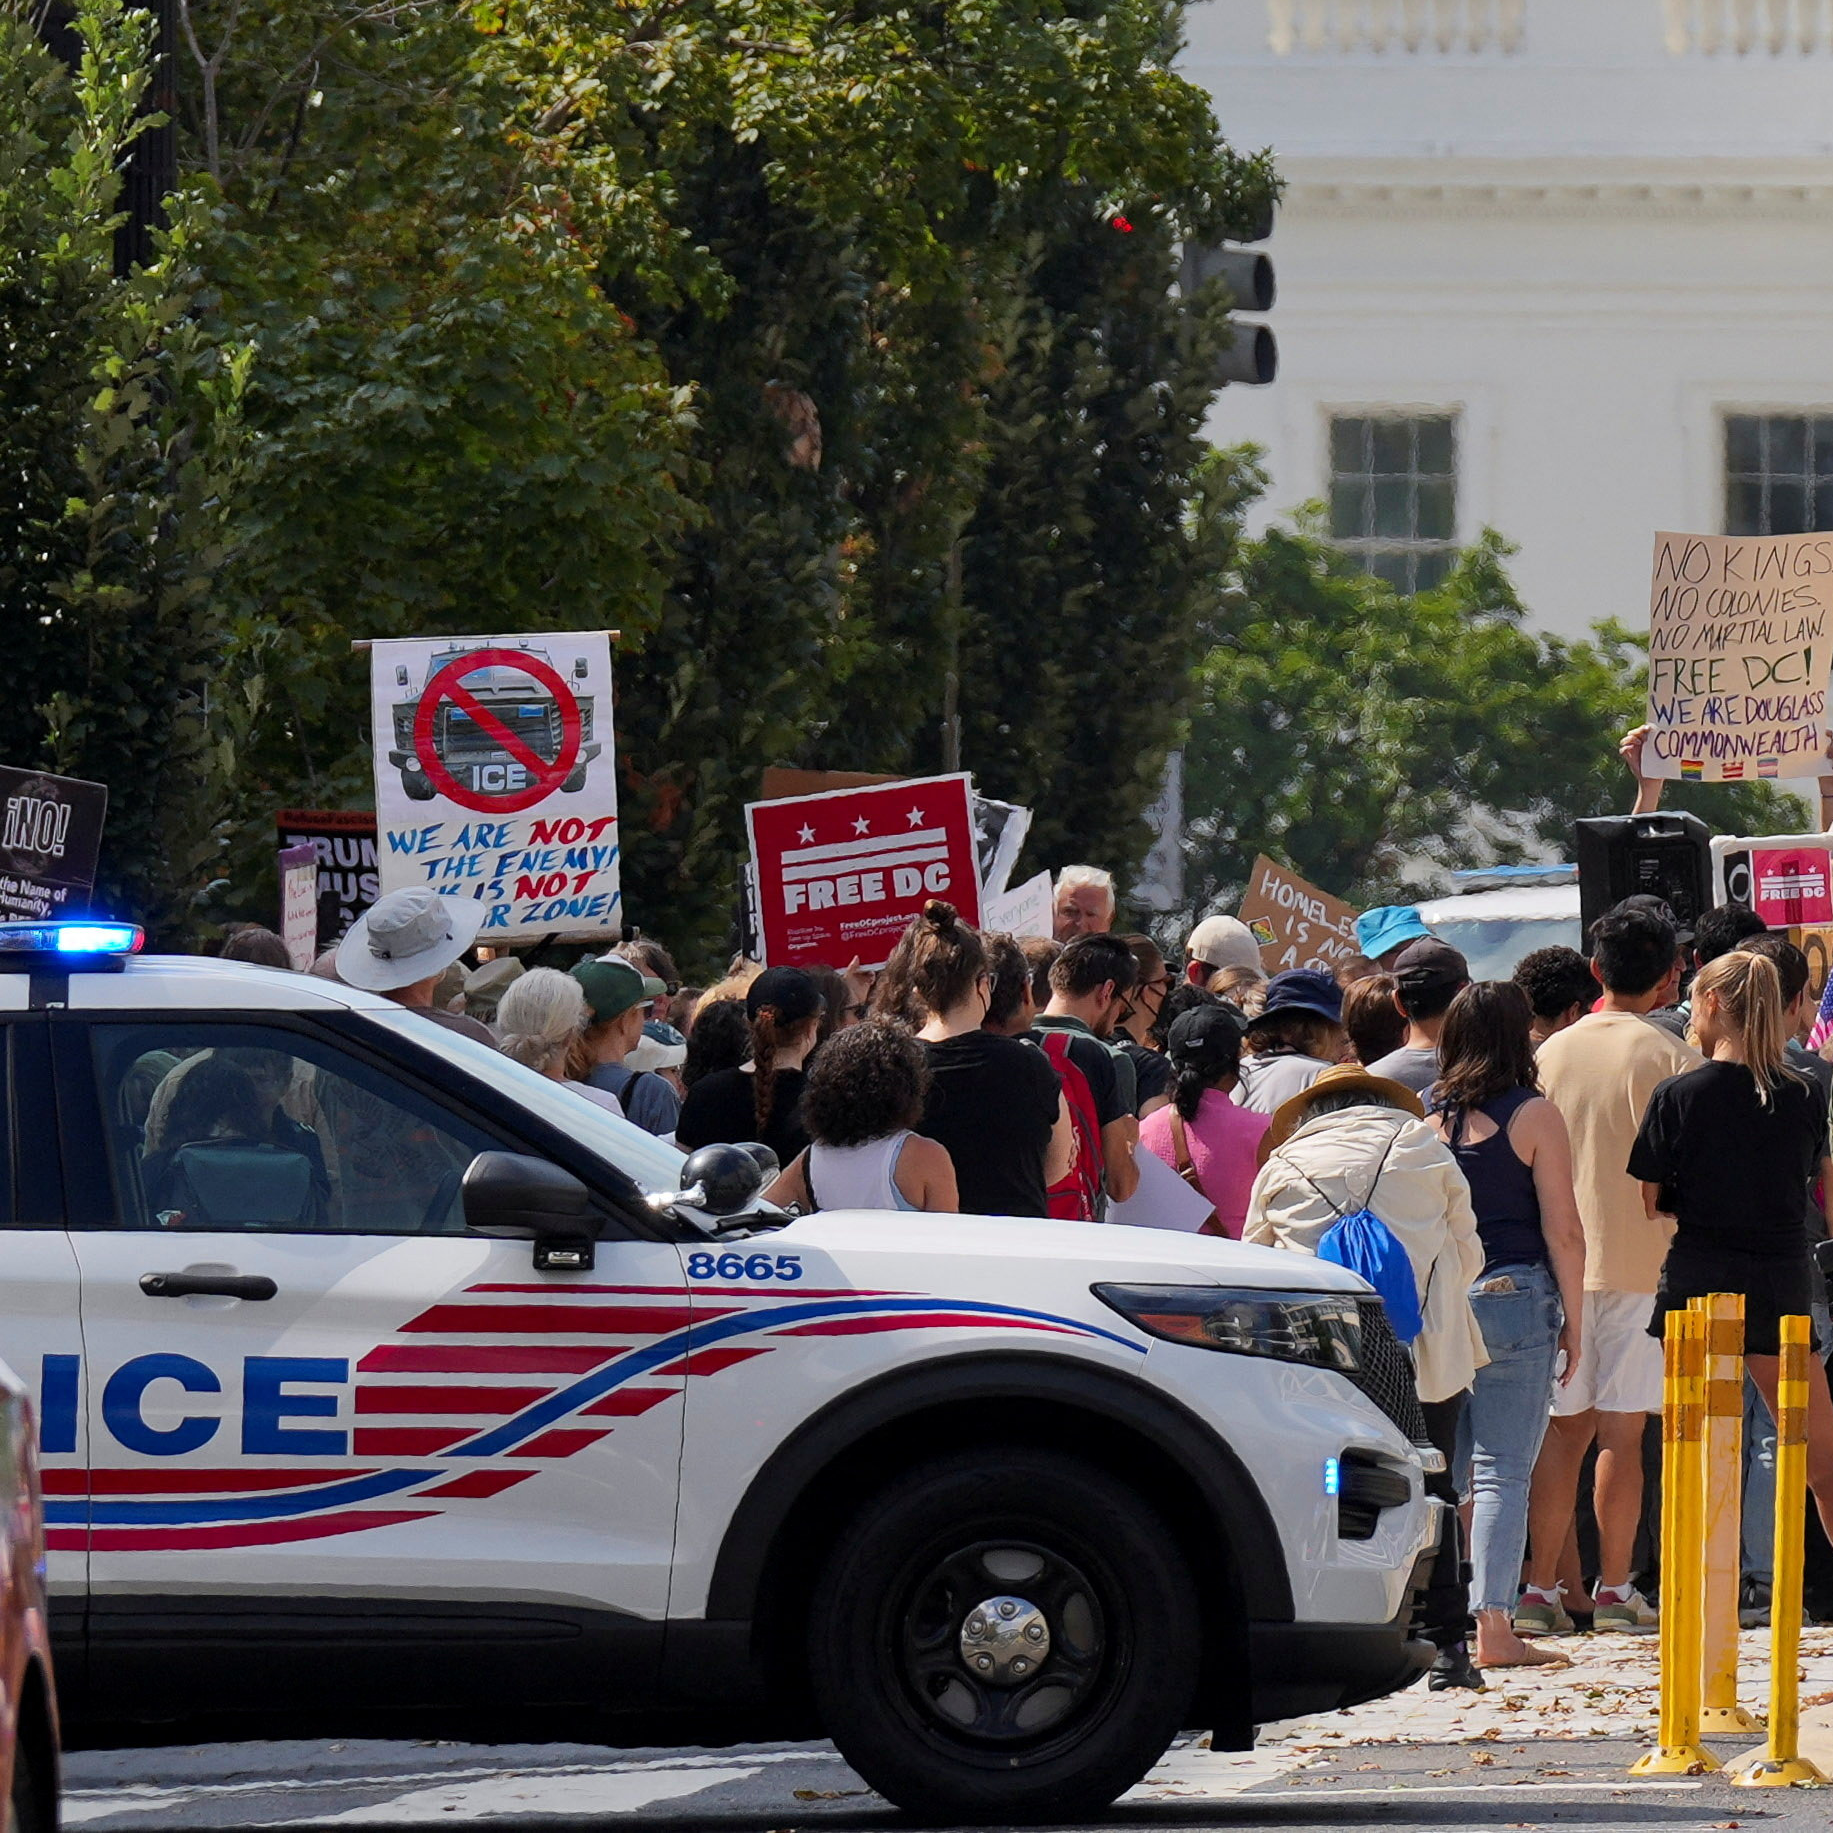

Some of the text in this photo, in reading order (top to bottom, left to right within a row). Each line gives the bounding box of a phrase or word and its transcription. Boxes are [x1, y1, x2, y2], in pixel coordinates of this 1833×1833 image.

[1656, 539, 1711, 584] NO
[1653, 585, 1699, 621] NO
[1652, 623, 1691, 651] NO
[1693, 618, 1778, 652] MARTIAL
[1653, 645, 1813, 696] FREE DC!
[1651, 690, 1825, 726] WE ARE DOUGLASS
[1654, 722, 1819, 760] COMMONWEALTH
[472, 763, 527, 792] ICE
[2, 796, 71, 857] ¡NO!
[386, 816, 618, 856] WE ARE NOT
[420, 845, 619, 881] THE ENEMY!
[20, 879, 51, 898] Name
[54, 888, 68, 903] of
[473, 879, 505, 901] IS
[514, 870, 599, 903] NOT
[783, 871, 886, 915] FREE
[892, 862, 951, 899] DC
[1760, 886, 1826, 902] FREE DC
[520, 890, 621, 926] ZONE!
[1285, 915, 1311, 944] IS
[687, 1252, 803, 1281] 8665
[40, 1352, 349, 1456] ICE
